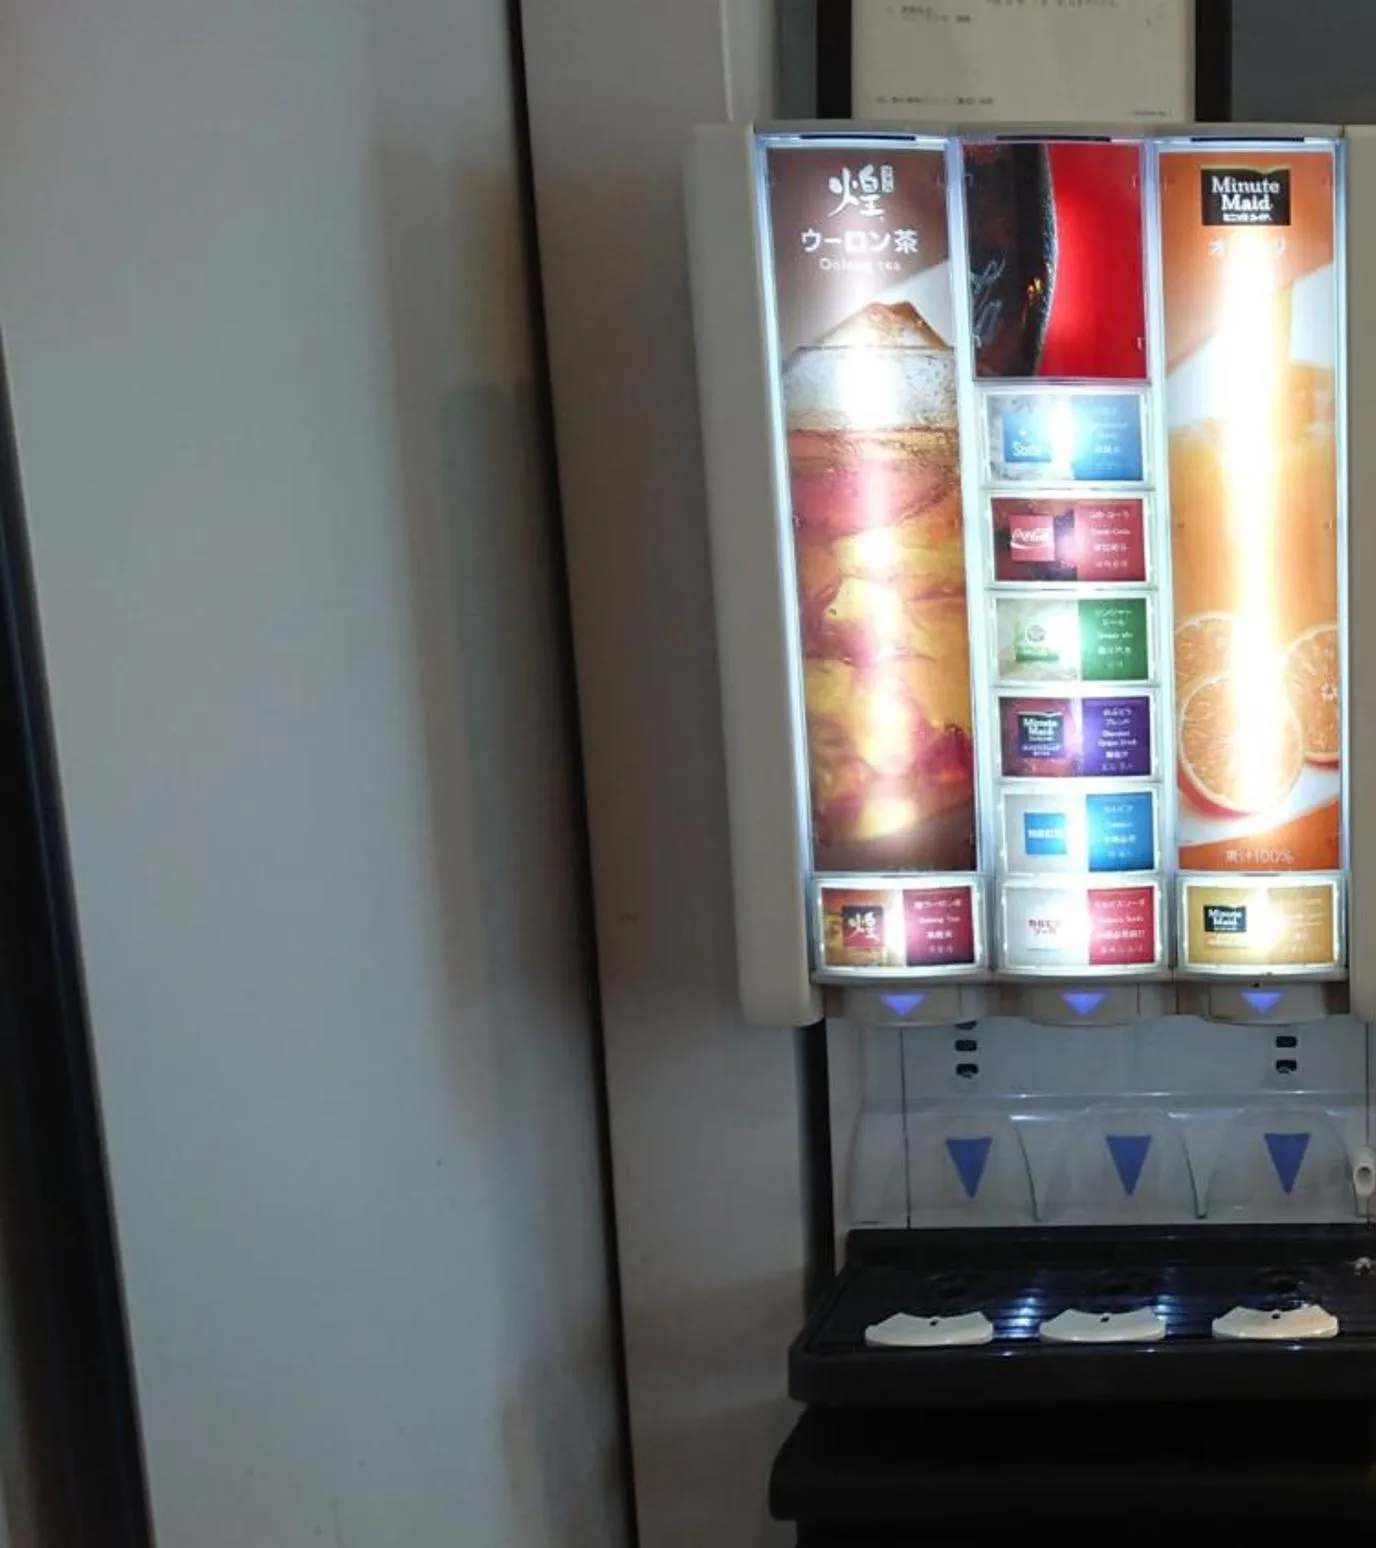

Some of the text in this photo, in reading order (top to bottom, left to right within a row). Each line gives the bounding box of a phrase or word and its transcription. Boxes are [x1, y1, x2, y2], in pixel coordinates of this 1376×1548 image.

[1212, 176, 1280, 193] Minute
[1221, 194, 1271, 211] Maid
[801, 229, 918, 254] ウーロン茶
[1023, 718, 1059, 728] Minute
[1226, 849, 1294, 864] 果汁100%
